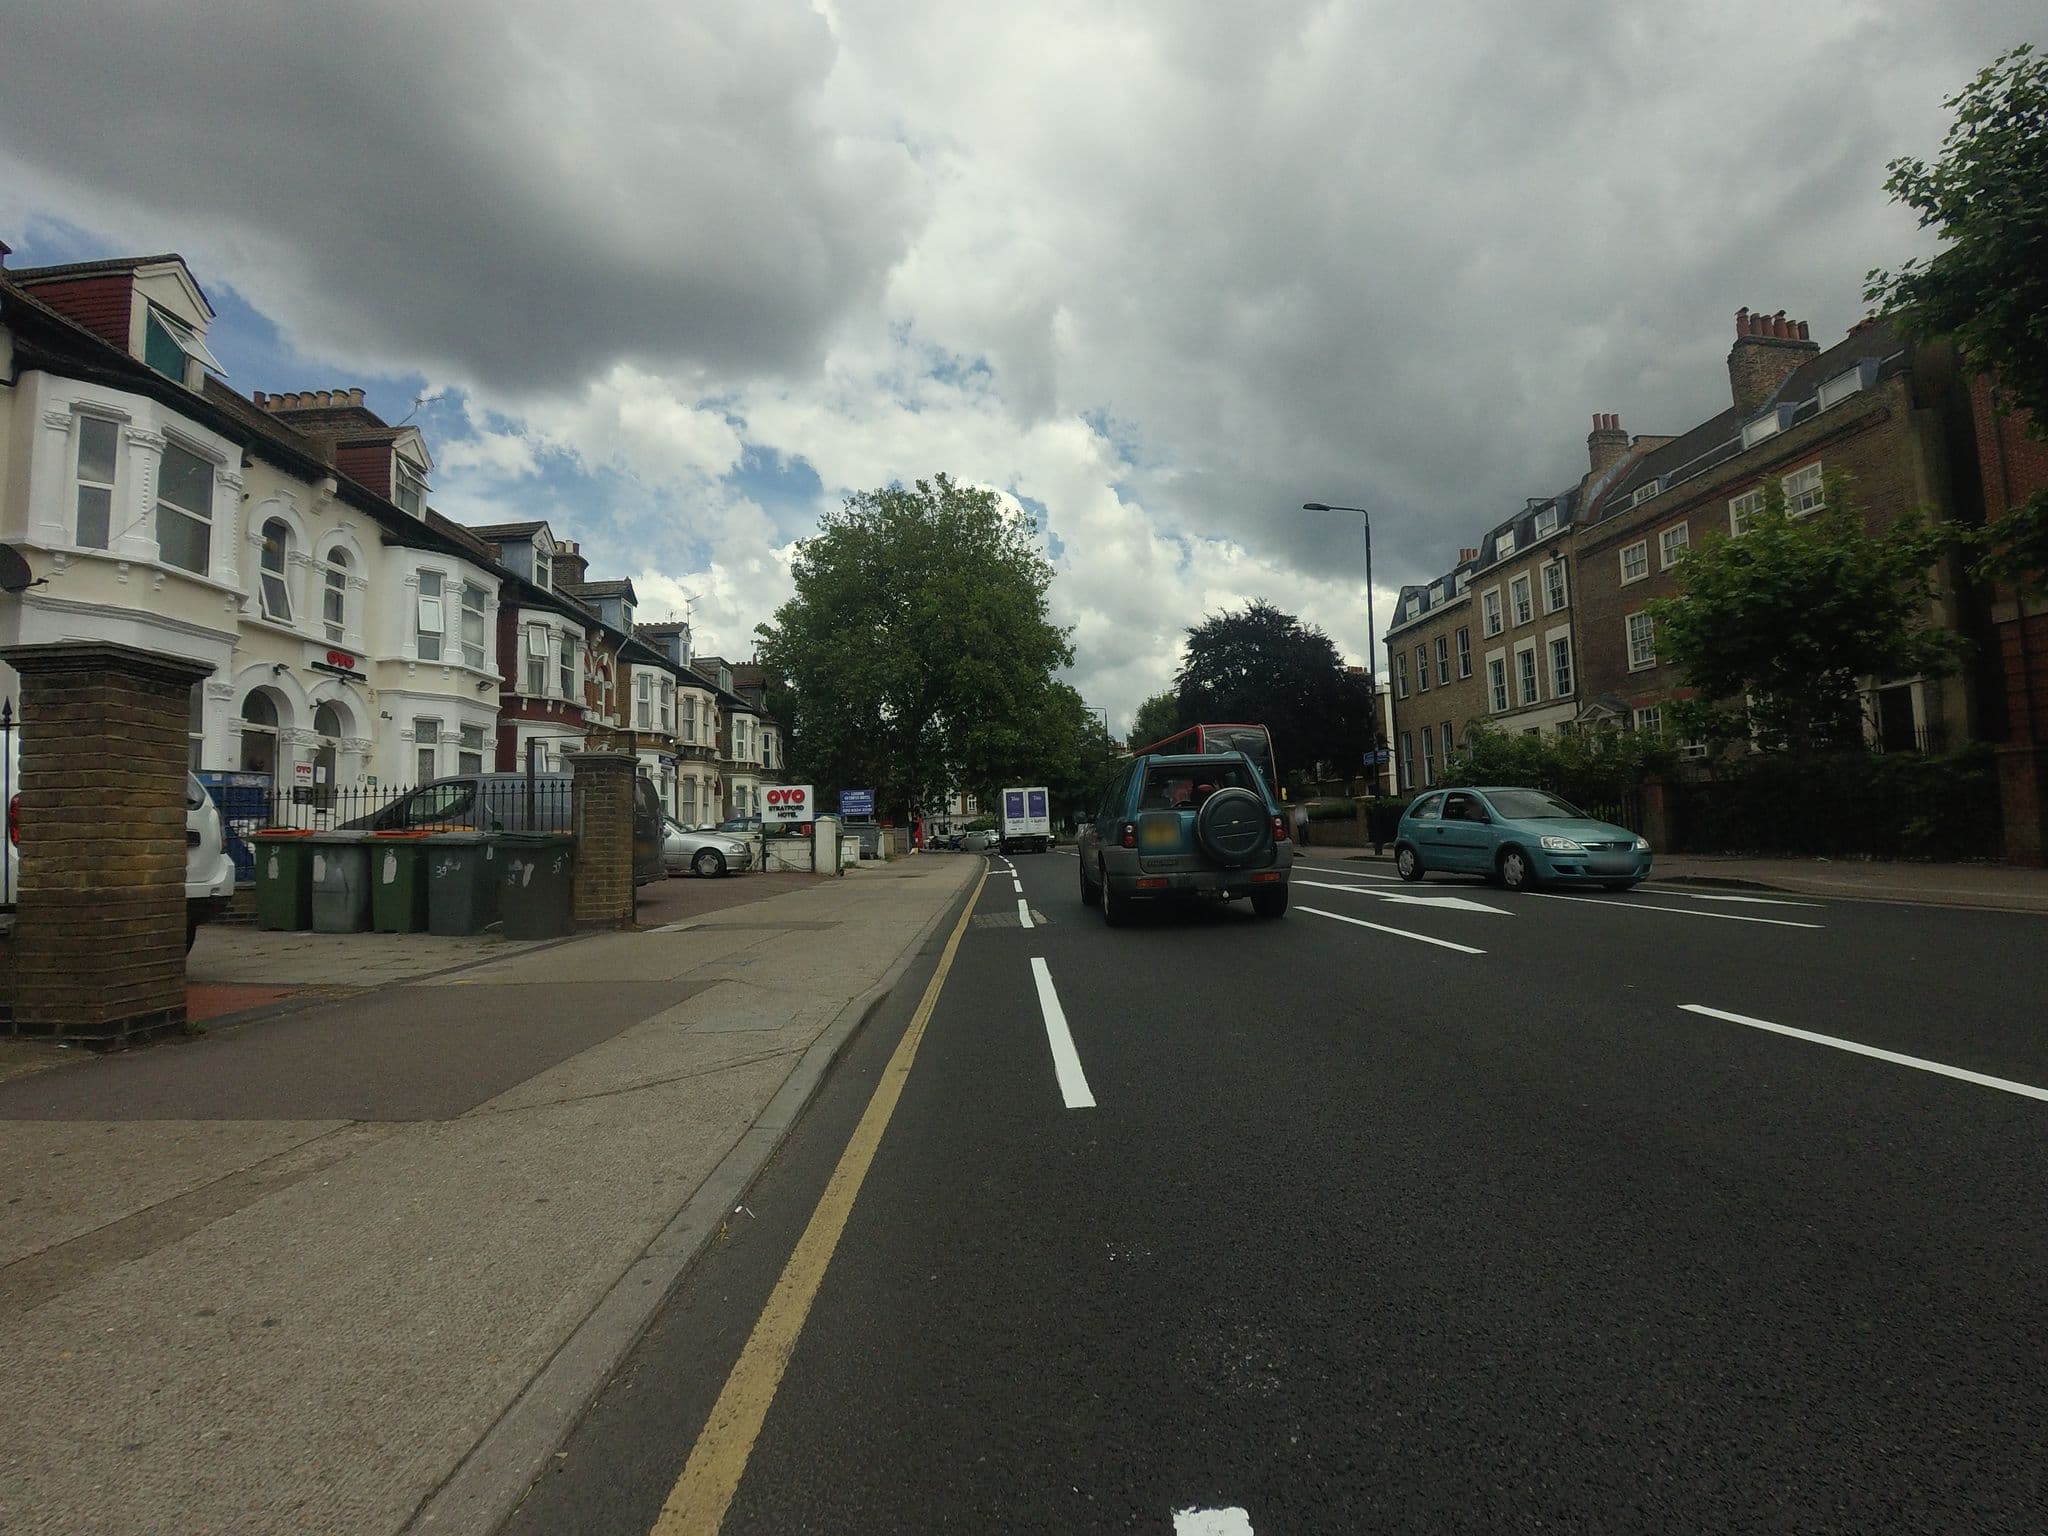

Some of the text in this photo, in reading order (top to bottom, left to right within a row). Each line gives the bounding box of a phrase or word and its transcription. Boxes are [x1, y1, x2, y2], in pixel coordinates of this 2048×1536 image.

[327, 650, 355, 669] OYO
[296, 765, 312, 774] OYO
[767, 789, 805, 804] OYO
[768, 804, 805, 812] STRATFORD
